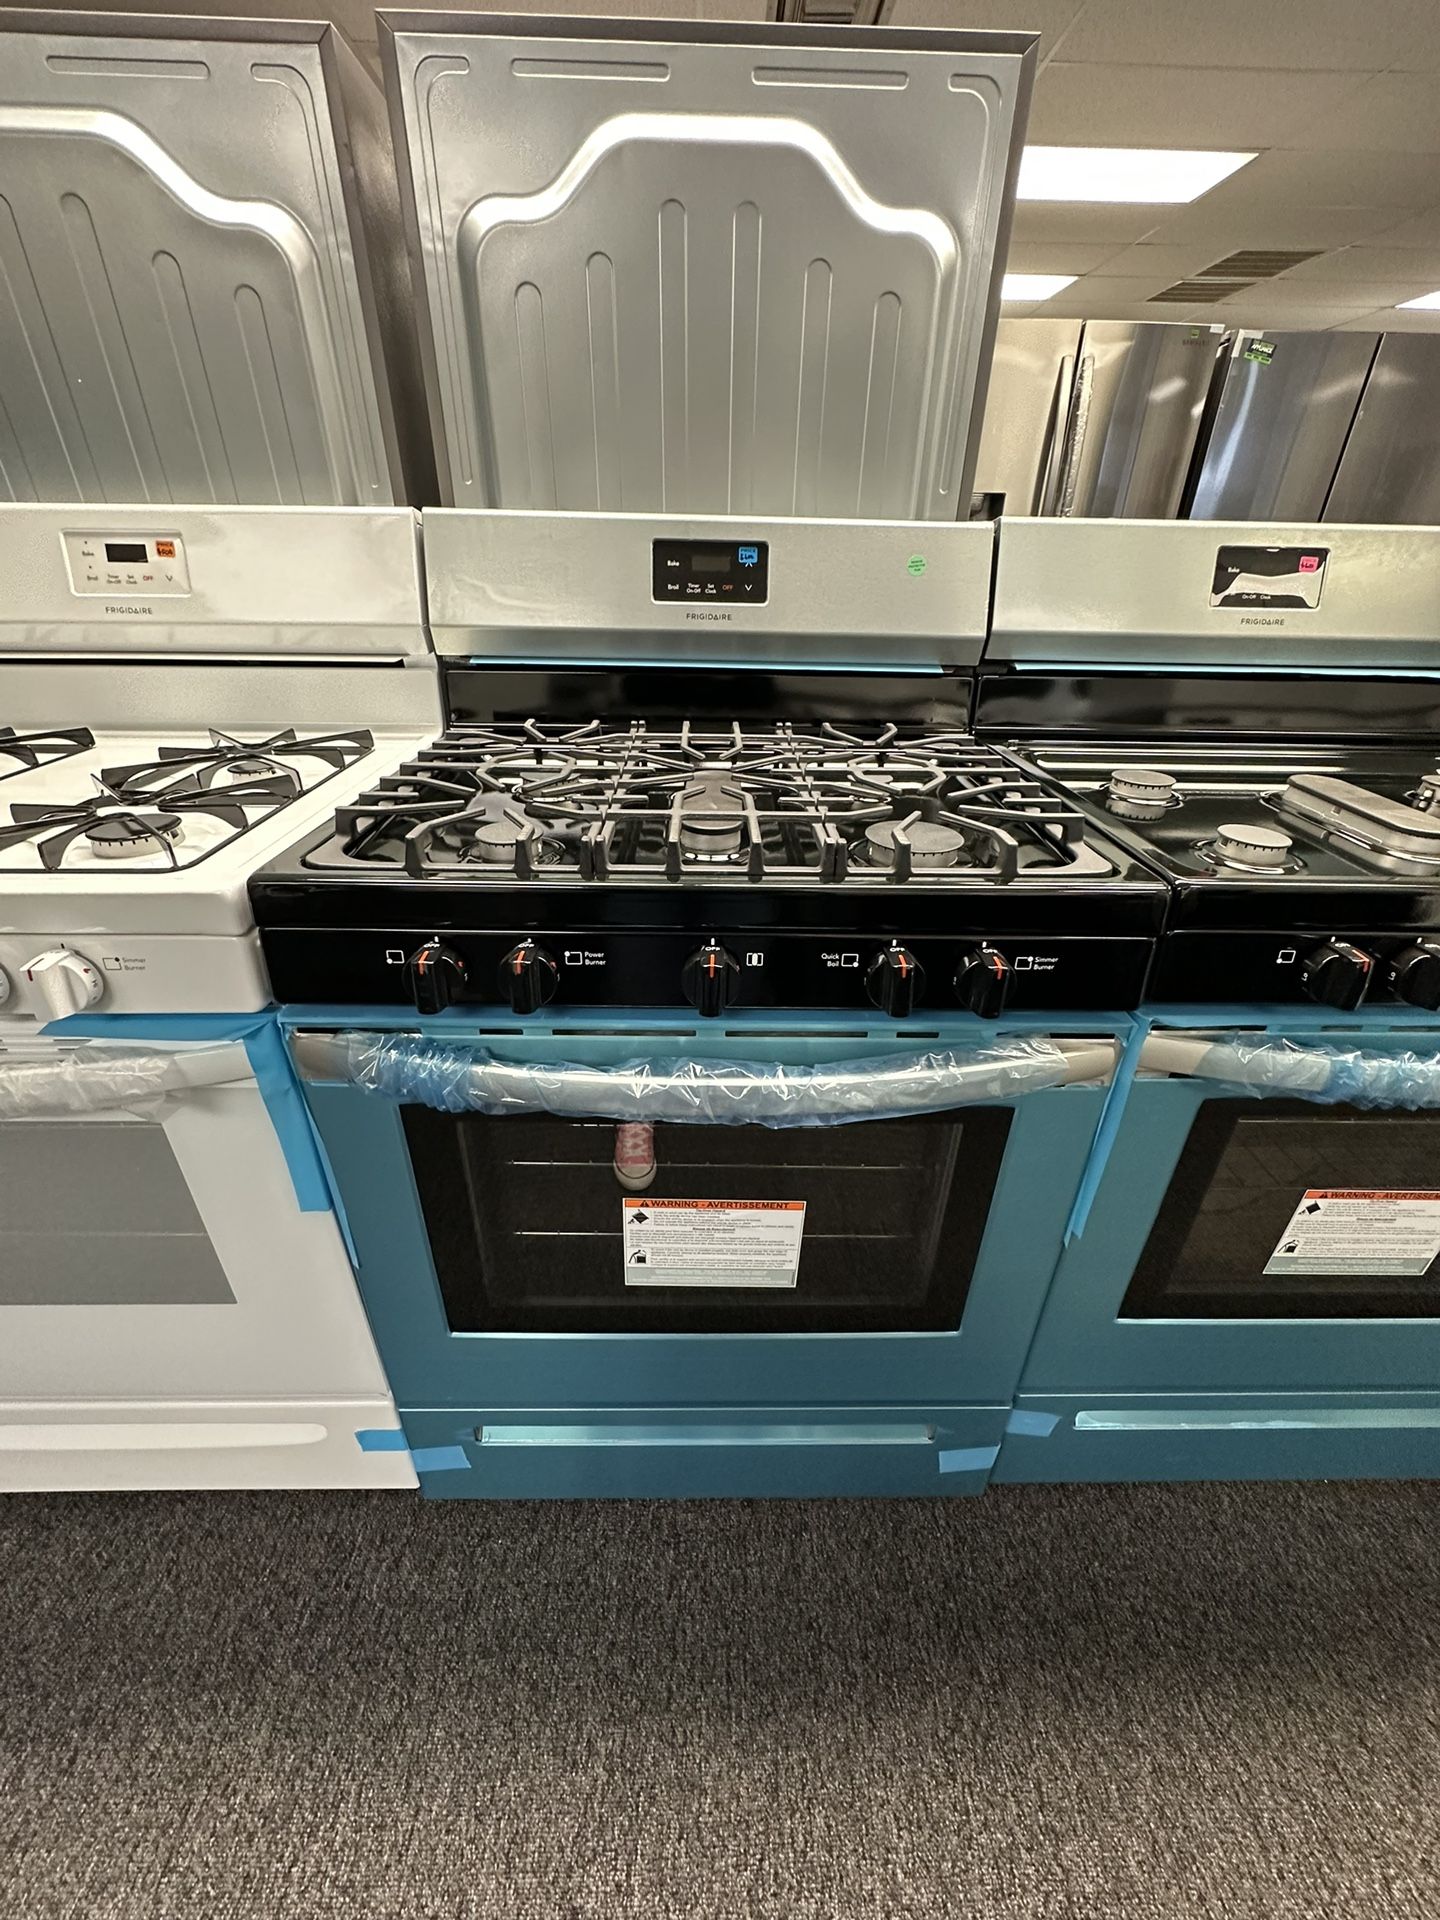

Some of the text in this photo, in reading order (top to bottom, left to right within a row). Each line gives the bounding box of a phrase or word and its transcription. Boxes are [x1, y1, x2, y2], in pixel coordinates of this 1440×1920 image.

[105, 606, 153, 615] FRIGIDAIRE
[686, 613, 732, 621] FRIGIDAIRE
[1240, 618, 1285, 626] FRIGIDAIRE
[584, 951, 604, 959] Power
[651, 1200, 699, 1208] WARNING
[707, 1201, 790, 1209] AVERTISSEMENT
